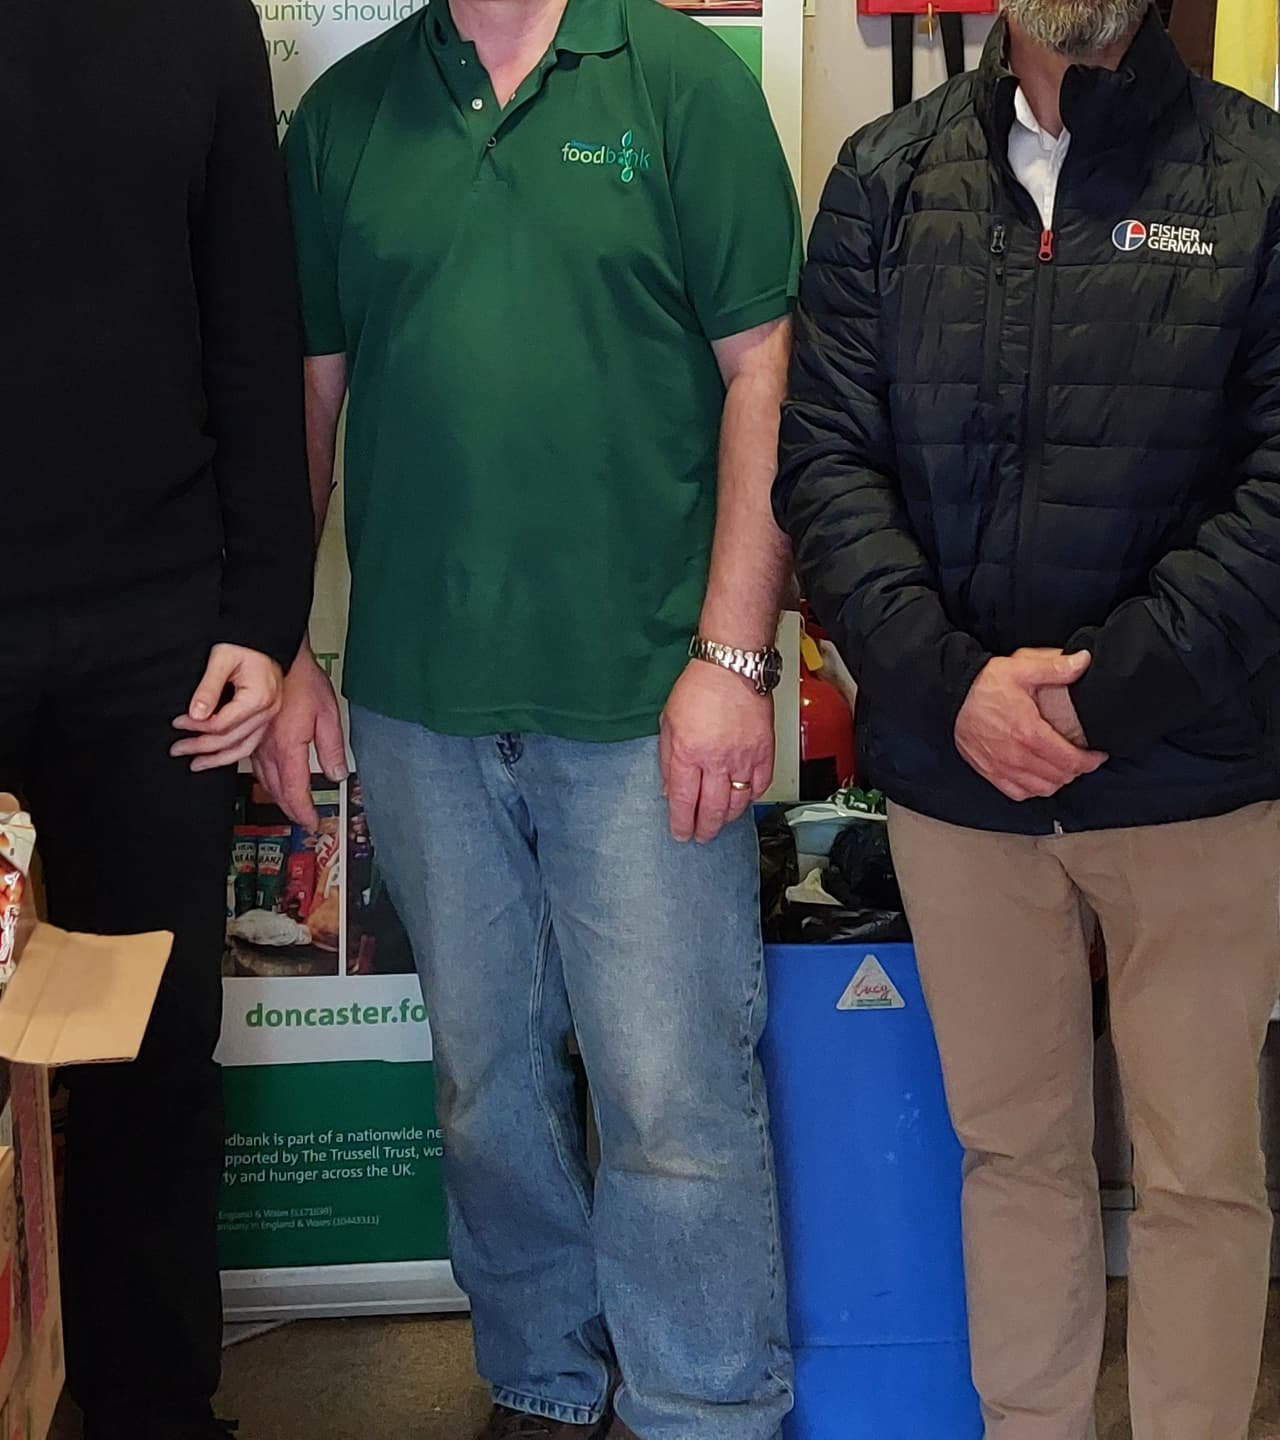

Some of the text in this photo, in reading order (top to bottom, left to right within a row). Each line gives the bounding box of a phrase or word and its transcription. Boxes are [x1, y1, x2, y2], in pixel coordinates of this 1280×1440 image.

[561, 142, 650, 168] foodbank
[1150, 223, 1200, 241] FISHER
[1148, 237, 1213, 255] GERMAN
[245, 999, 429, 1029] doncaster.fo
[273, 1127, 423, 1148] is part of a nationwide
[282, 1146, 419, 1166] by The Trussell Trust,
[240, 1164, 415, 1184] and hunger across the UK.
